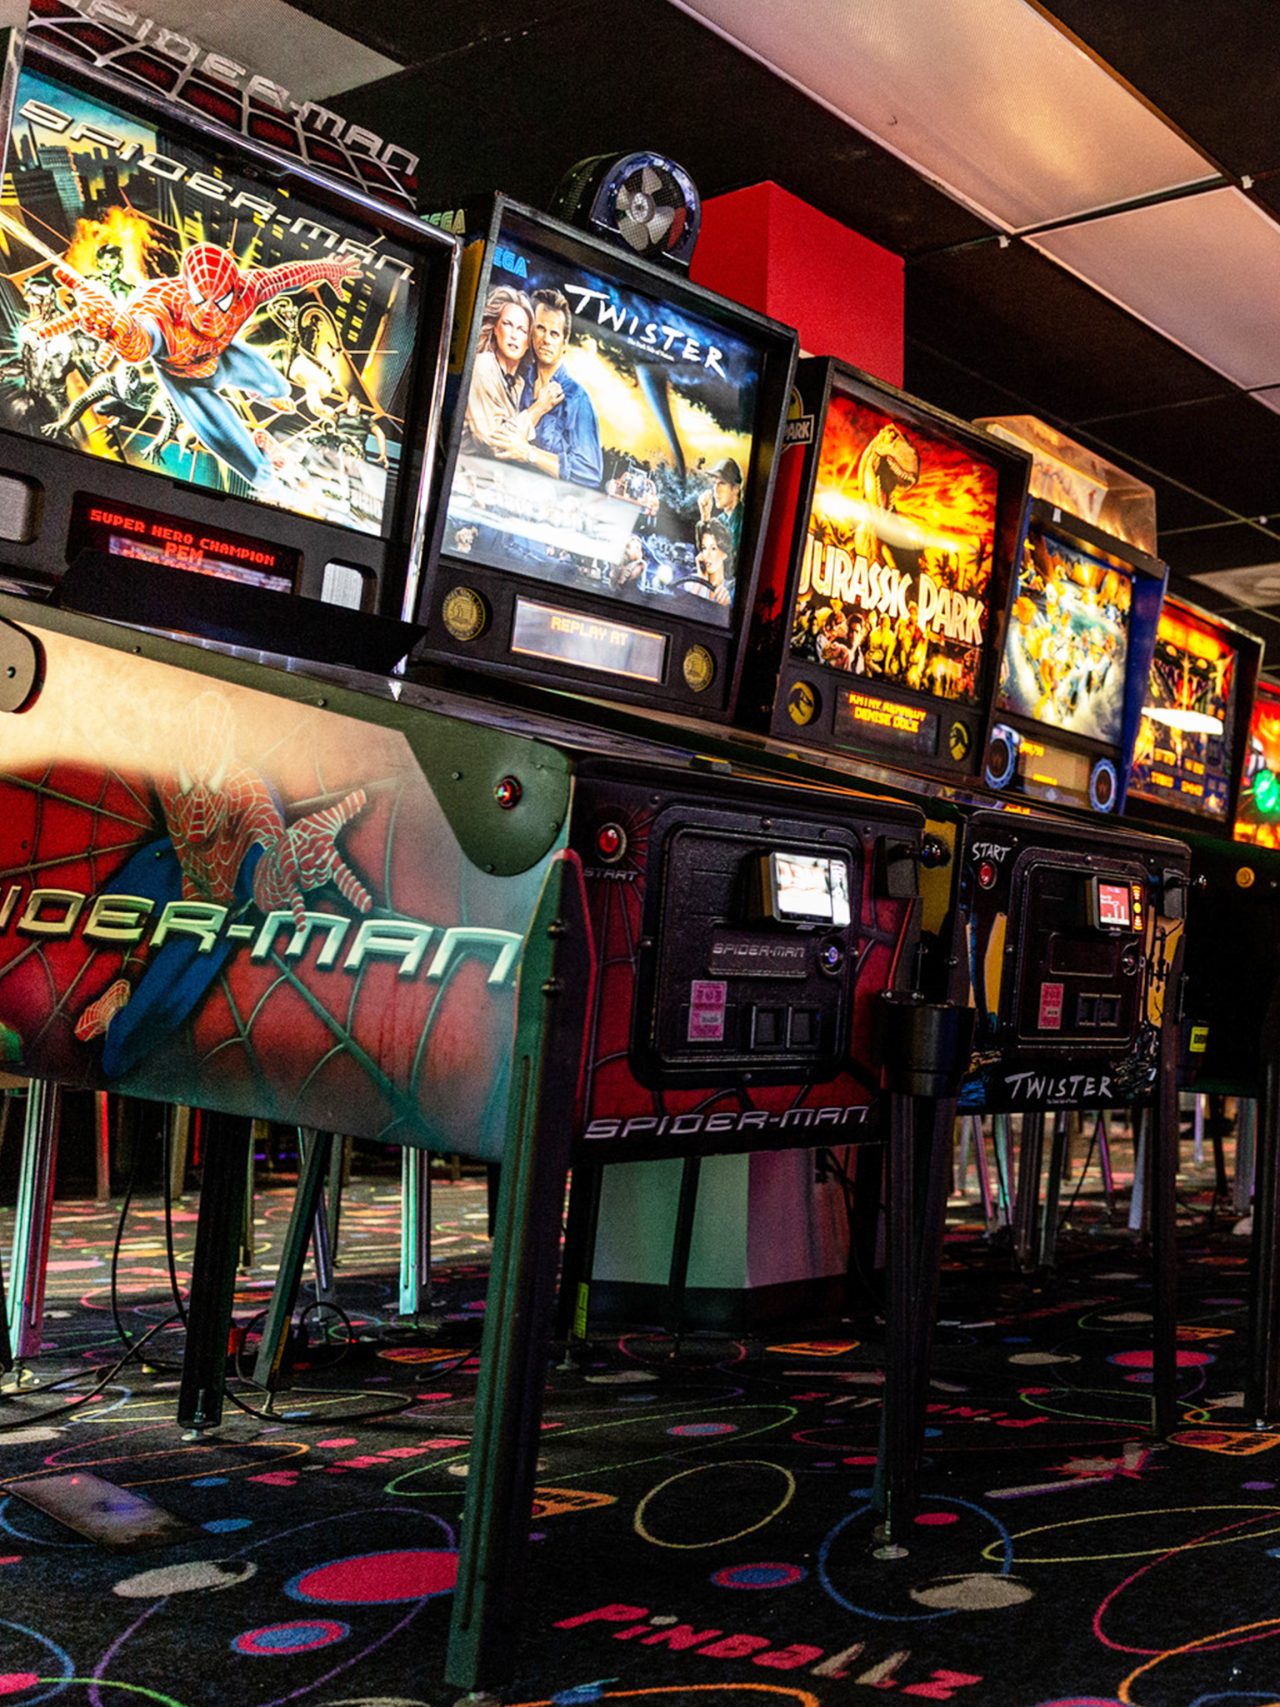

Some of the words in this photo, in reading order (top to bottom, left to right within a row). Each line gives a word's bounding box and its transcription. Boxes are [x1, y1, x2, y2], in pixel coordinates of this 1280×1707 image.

[57, 0, 420, 175] PIDER-MAN
[18, 99, 414, 281] SPIDER-MAN
[564, 283, 727, 381] TWISTER
[90, 509, 145, 533] SUPER
[151, 525, 194, 546] HERO
[199, 538, 276, 567] CHAMPION
[798, 533, 912, 620] JURASSIC
[917, 573, 985, 645] PARK
[550, 615, 607, 640] REPLAY
[609, 630, 630, 646] AT
[583, 867, 638, 881] START
[972, 842, 1012, 863] START
[0, 885, 524, 984] IDER-MAN
[712, 943, 805, 958] SPIDER-MAN
[1004, 1071, 1112, 1099] TWISTER
[584, 1106, 869, 1139] SPIDER-MAN
